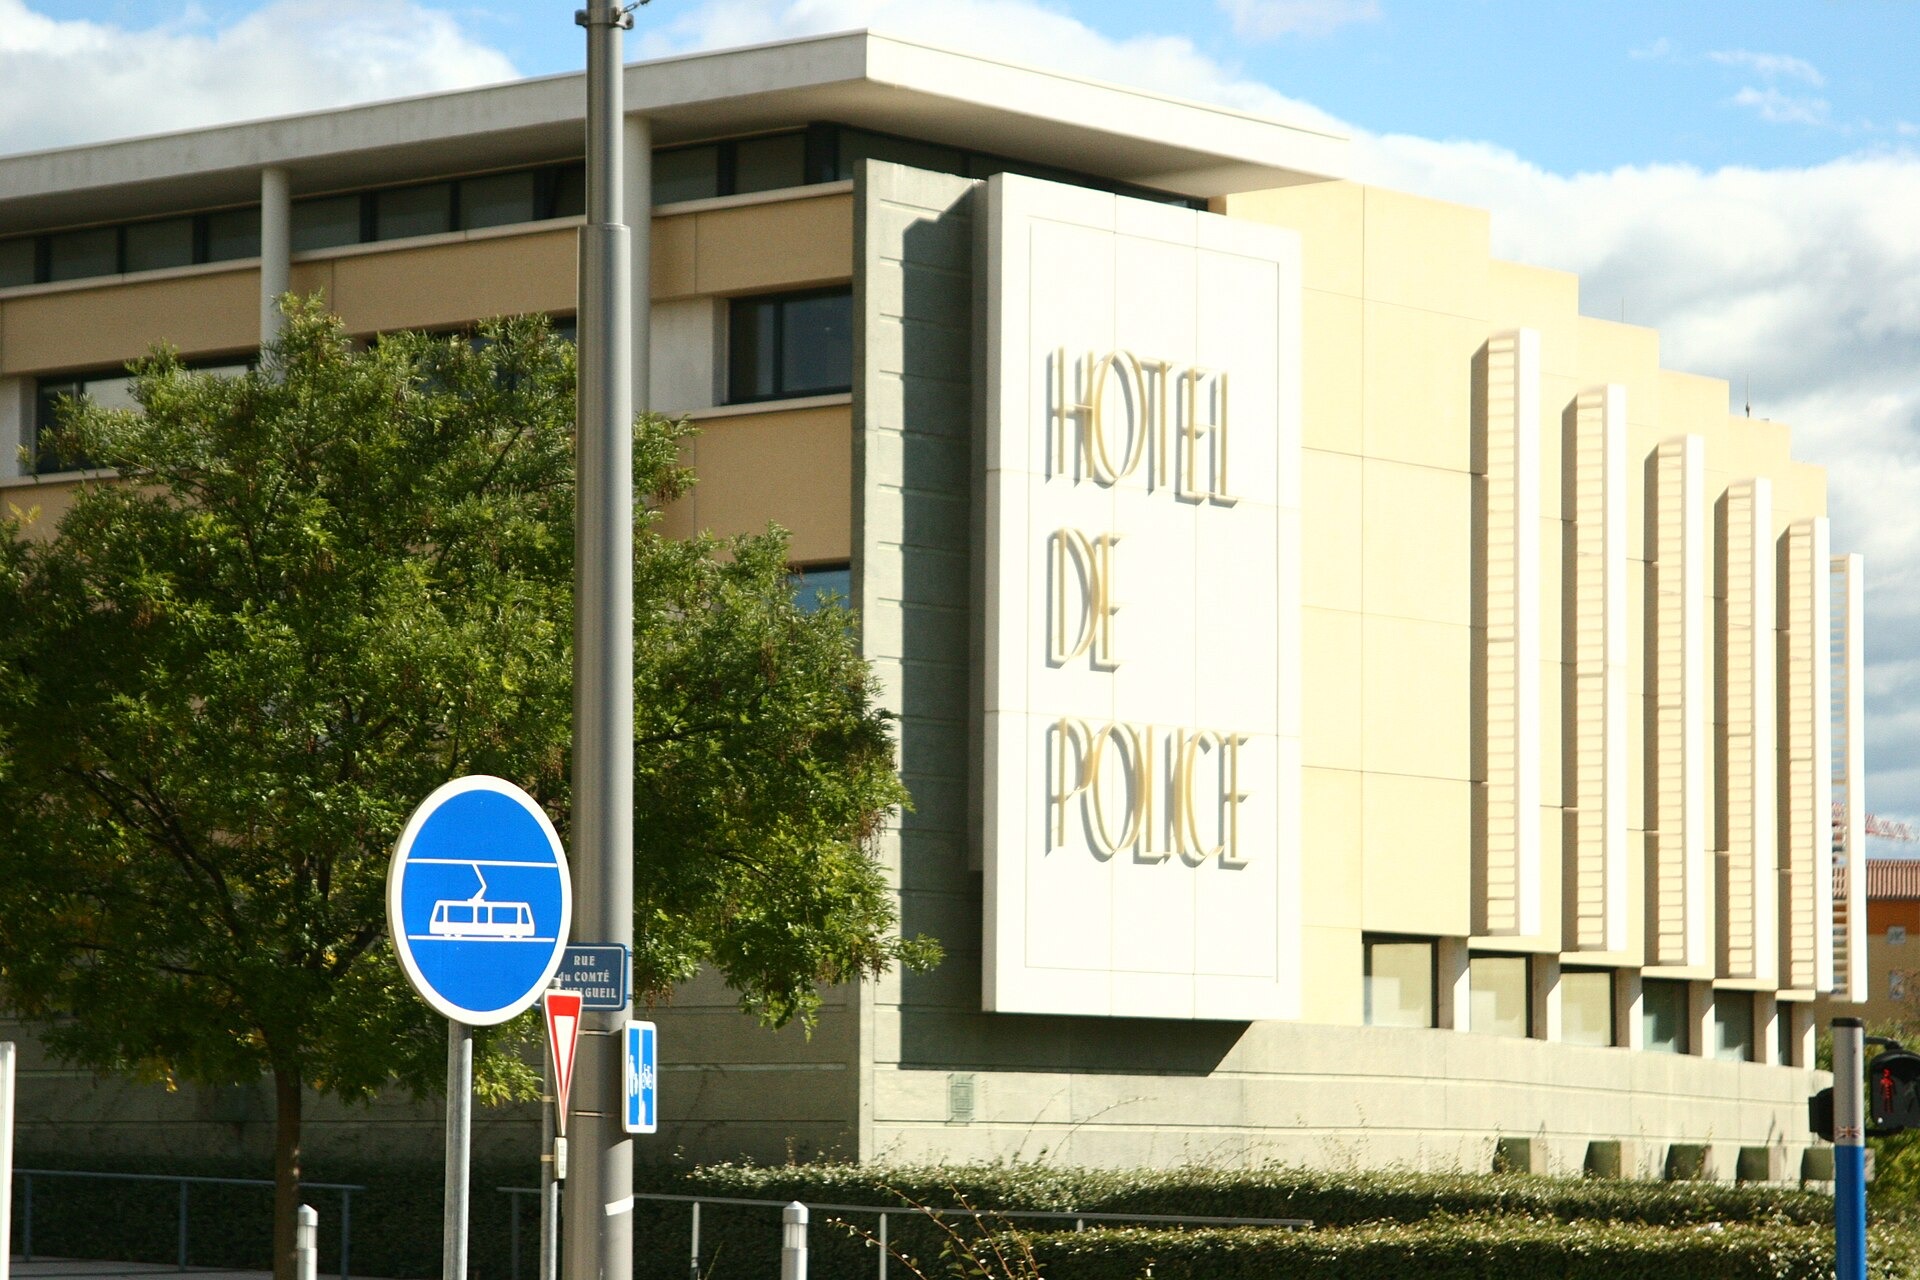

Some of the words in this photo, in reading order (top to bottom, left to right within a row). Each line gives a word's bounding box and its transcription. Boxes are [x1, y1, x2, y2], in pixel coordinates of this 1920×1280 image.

[1045, 346, 1238, 508] HOTEL
[1045, 526, 1120, 672] DE
[1045, 716, 1248, 870] POLICE
[558, 971, 571, 982] du
[574, 969, 610, 982] COMTÉ
[564, 987, 617, 998] GUEIL
[573, 955, 595, 966] RUE
